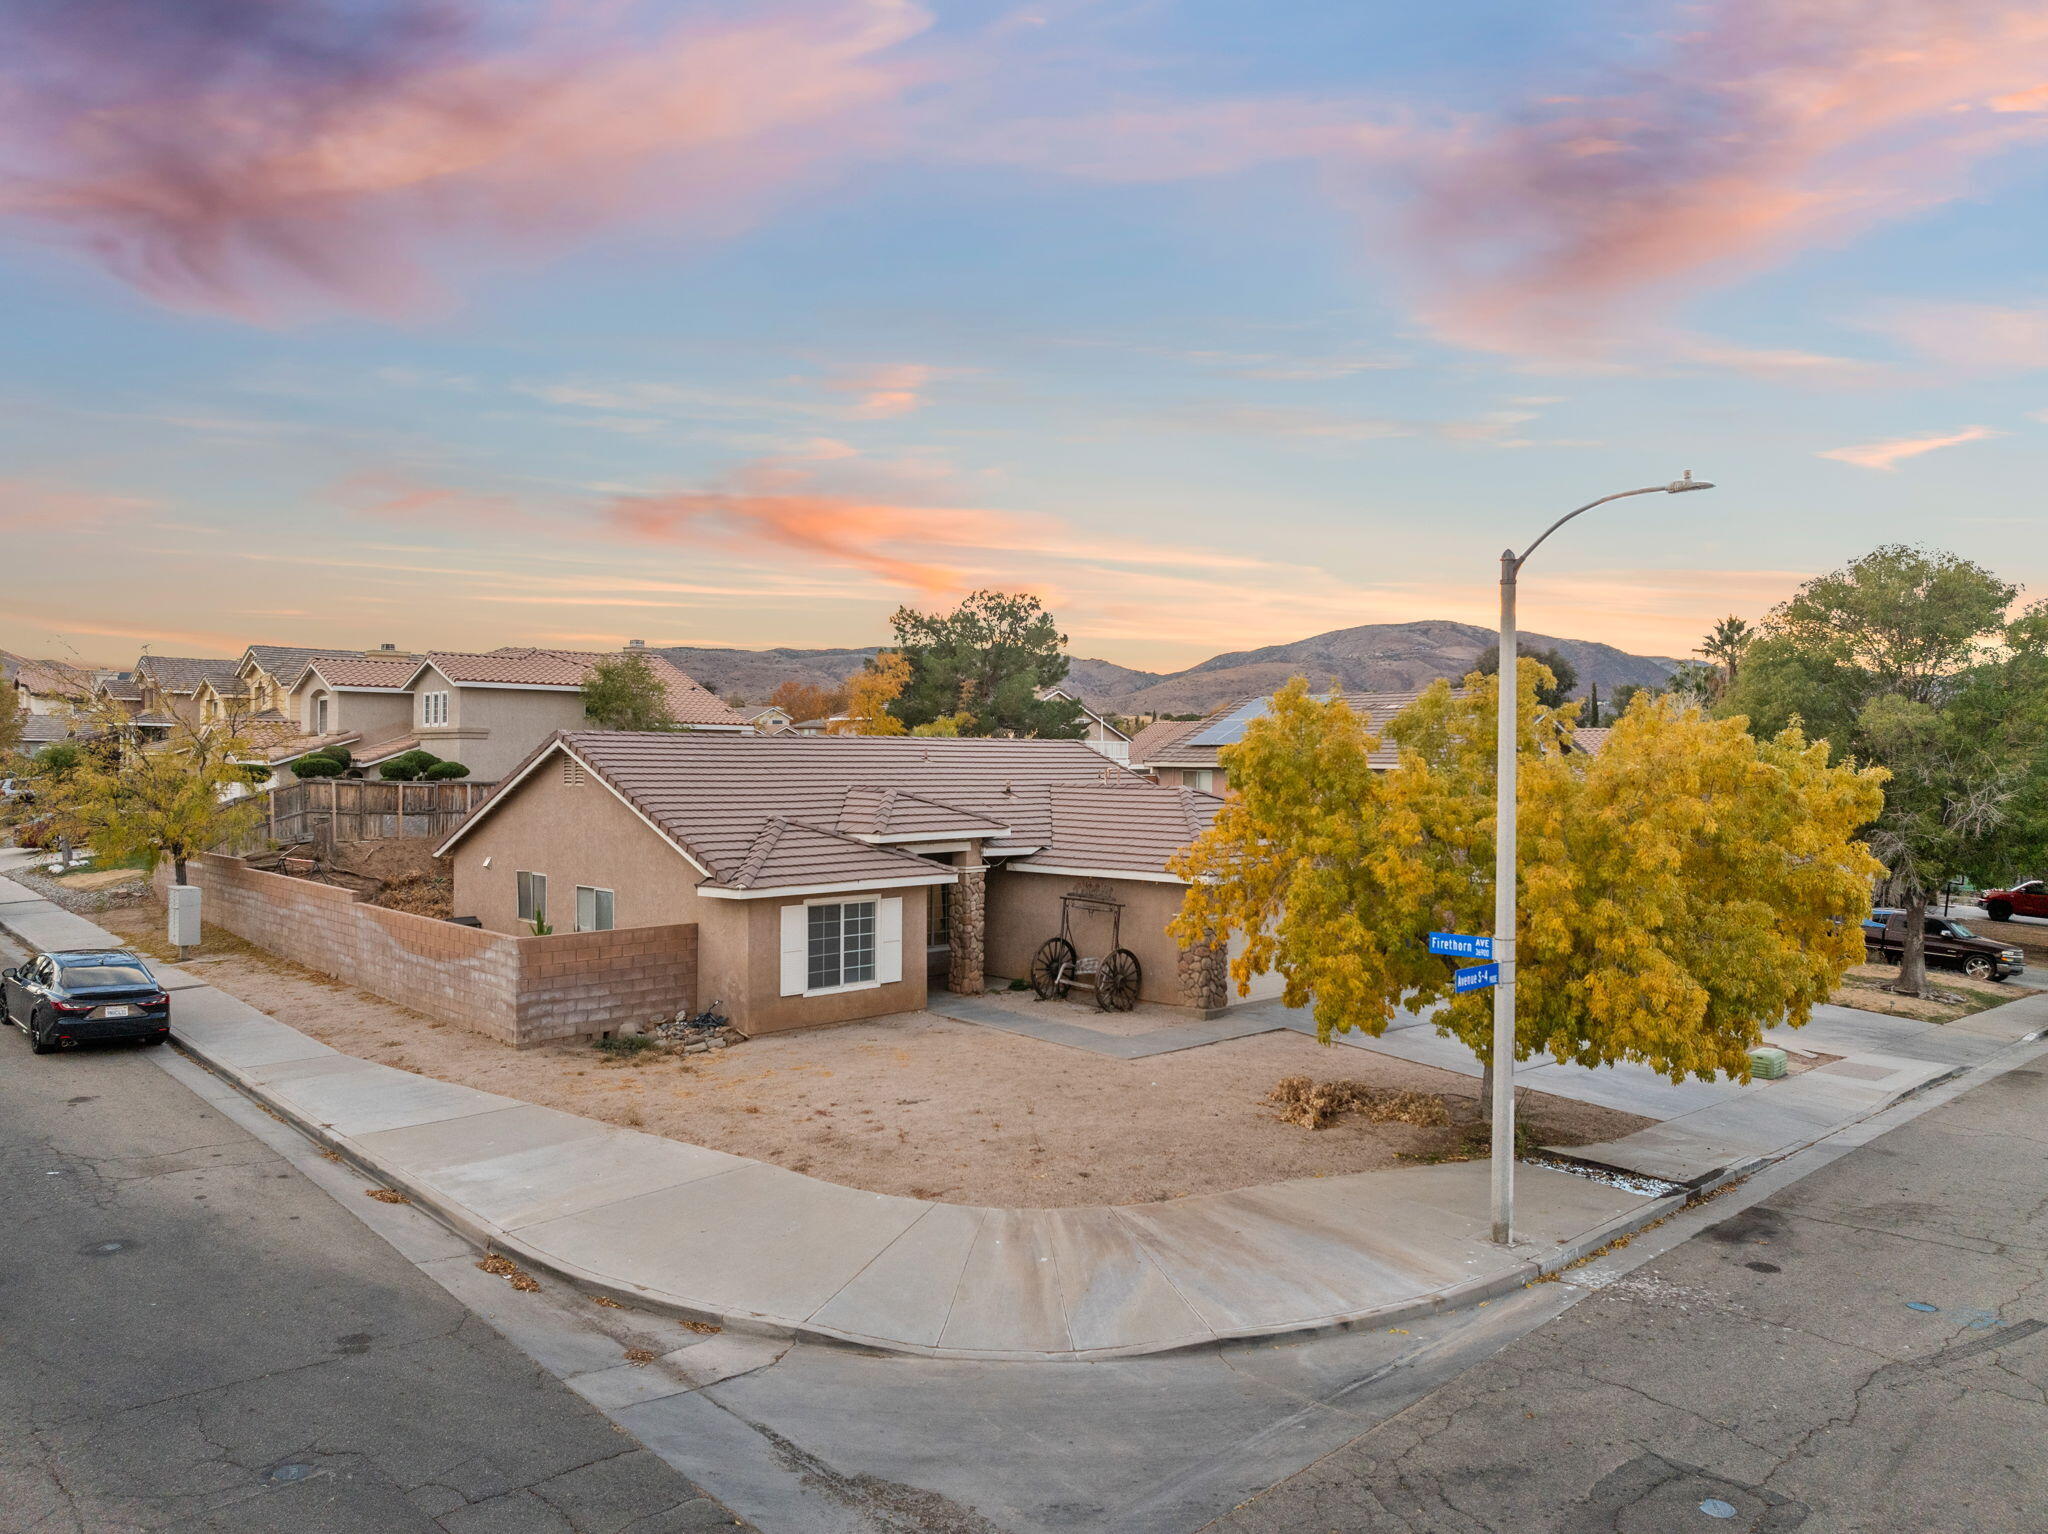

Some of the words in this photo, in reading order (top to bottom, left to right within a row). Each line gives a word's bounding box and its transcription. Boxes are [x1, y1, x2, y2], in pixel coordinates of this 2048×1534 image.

[1432, 937, 1472, 952] Firethorn
[1475, 939, 1490, 948] AVE
[1458, 975, 1477, 987] Avenue
[1478, 970, 1488, 983] S-4
